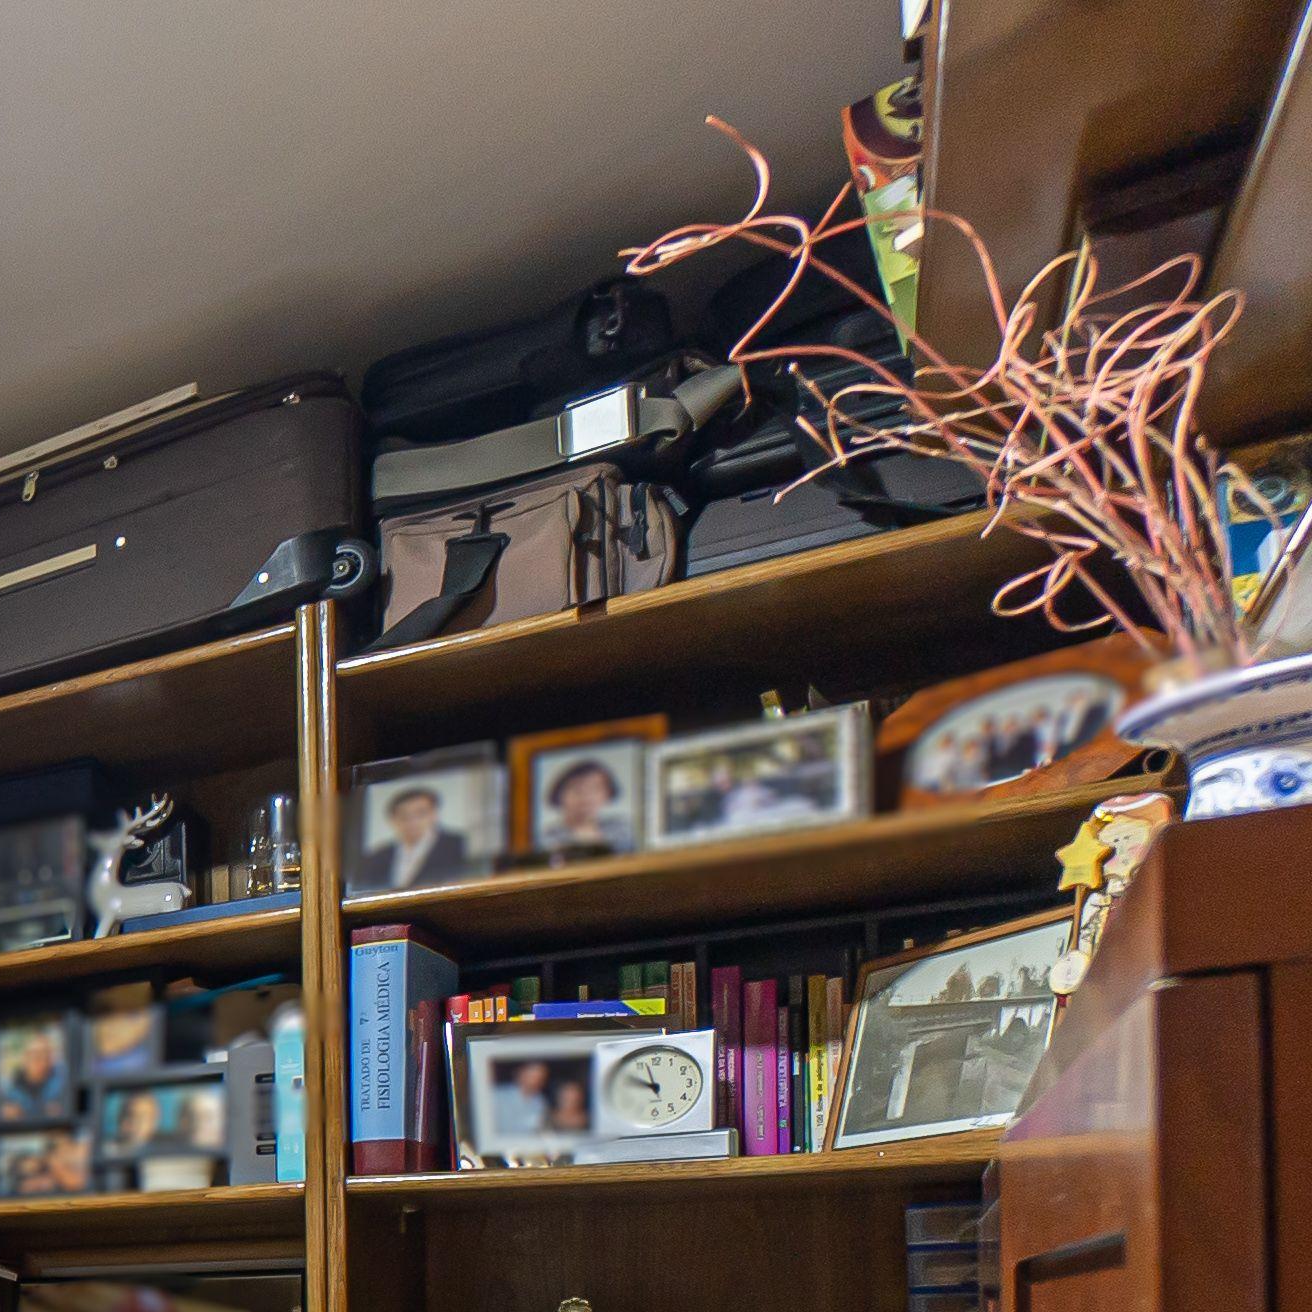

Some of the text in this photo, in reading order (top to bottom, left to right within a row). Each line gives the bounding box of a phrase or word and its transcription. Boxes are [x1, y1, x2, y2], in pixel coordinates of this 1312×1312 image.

[354, 944, 399, 957] Guyton
[374, 961, 391, 1110] FISIOLOGIA MÉDICA
[360, 1039, 370, 1054] DE
[651, 1057, 661, 1066] 12
[680, 1066, 687, 1076] 2
[360, 1056, 371, 1112] TRATADO
[686, 1078, 693, 1088] 3
[680, 1092, 687, 1101] 4
[651, 1108, 659, 1117] 6
[667, 1103, 675, 1112] 5
